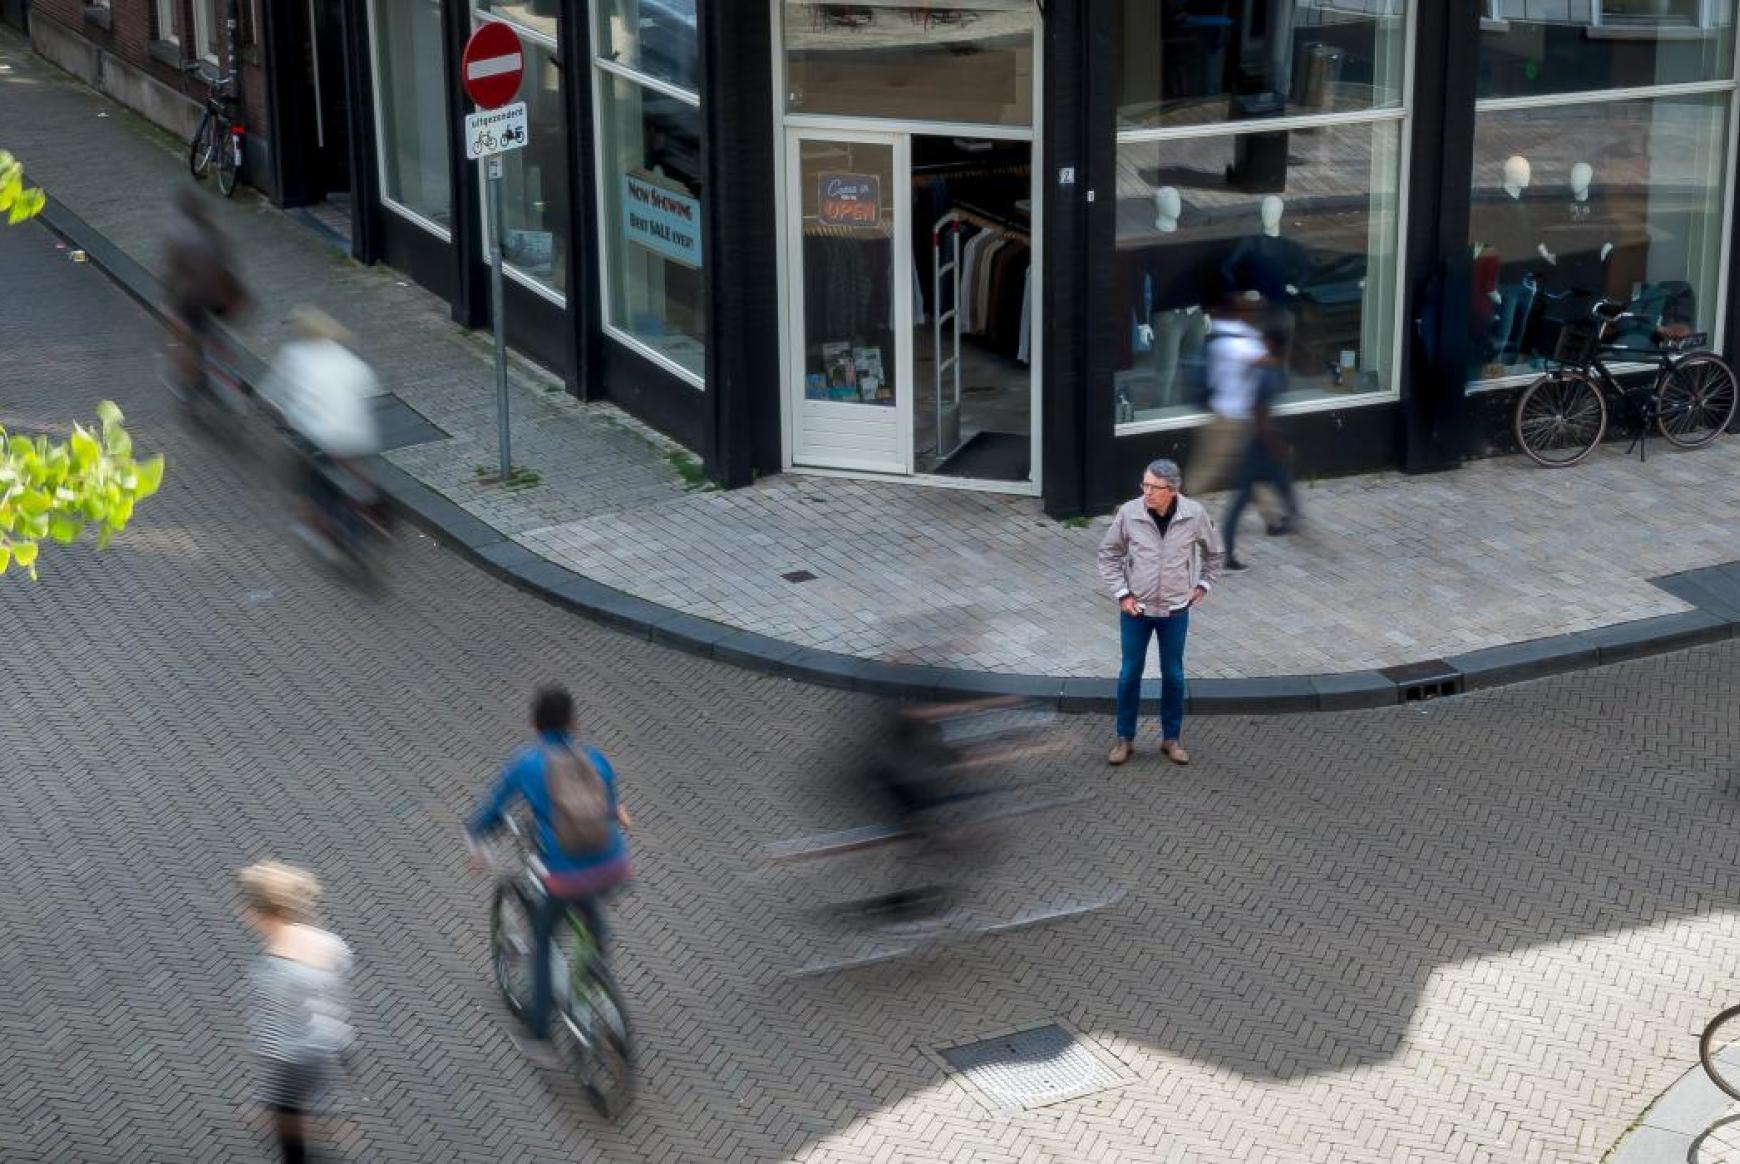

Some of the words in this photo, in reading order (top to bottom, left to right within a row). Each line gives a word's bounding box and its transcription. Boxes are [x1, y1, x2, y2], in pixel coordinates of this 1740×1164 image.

[472, 107, 523, 128] uitgezonderd
[628, 180, 649, 205] NOW
[629, 212, 648, 232] BEST
[650, 220, 671, 241] SALE
